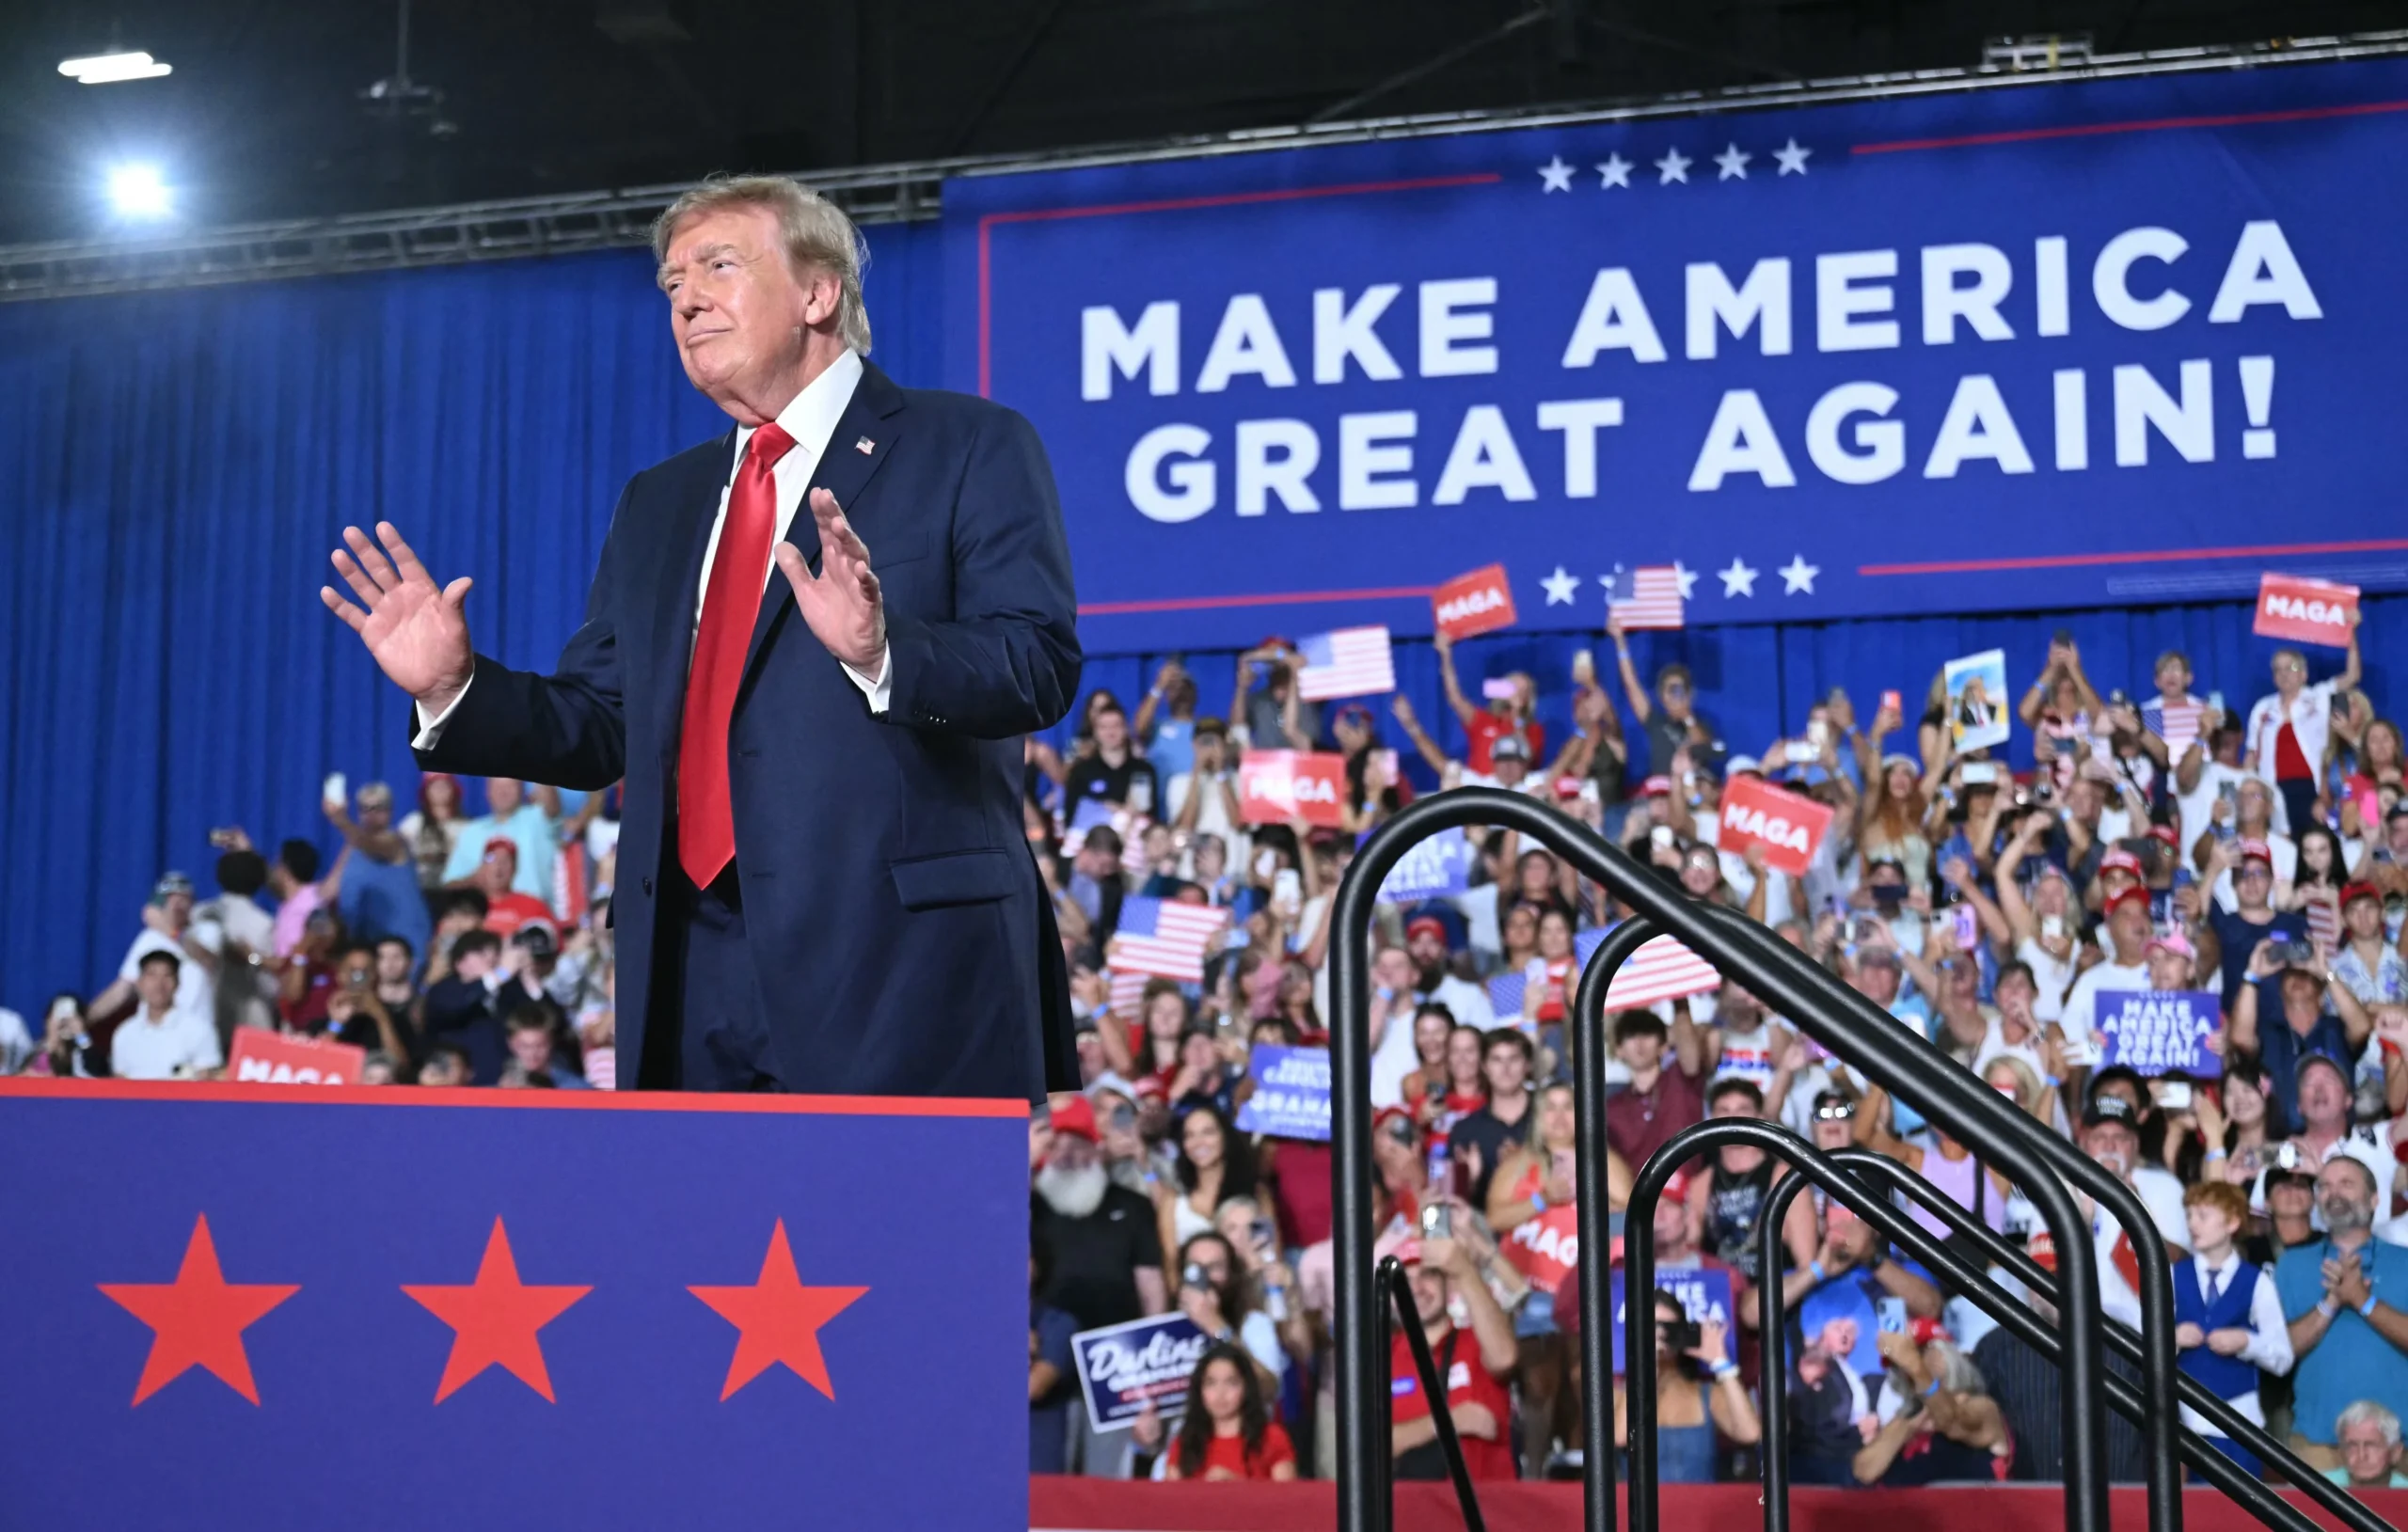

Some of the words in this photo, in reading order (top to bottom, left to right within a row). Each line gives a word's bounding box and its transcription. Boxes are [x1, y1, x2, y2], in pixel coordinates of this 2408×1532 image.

[1081, 277, 1498, 402] MAKE
[1561, 220, 2323, 369] AMERICA
[1125, 397, 1624, 523] GREAT
[1687, 355, 2276, 491] AGAIN!
[1436, 586, 1505, 624] MAGA
[2265, 593, 2346, 626] MAGA
[1250, 775, 1337, 803] MGA
[1723, 802, 1809, 853] MAGA
[2123, 1000, 2191, 1017] MAKE
[2102, 1014, 2212, 1035] AMERICA
[2115, 1048, 2199, 1066] AGAIN!
[2117, 1033, 2196, 1052] GREAT
[1249, 1089, 1331, 1116] GRAHA
[1512, 1219, 1579, 1268] MAG
